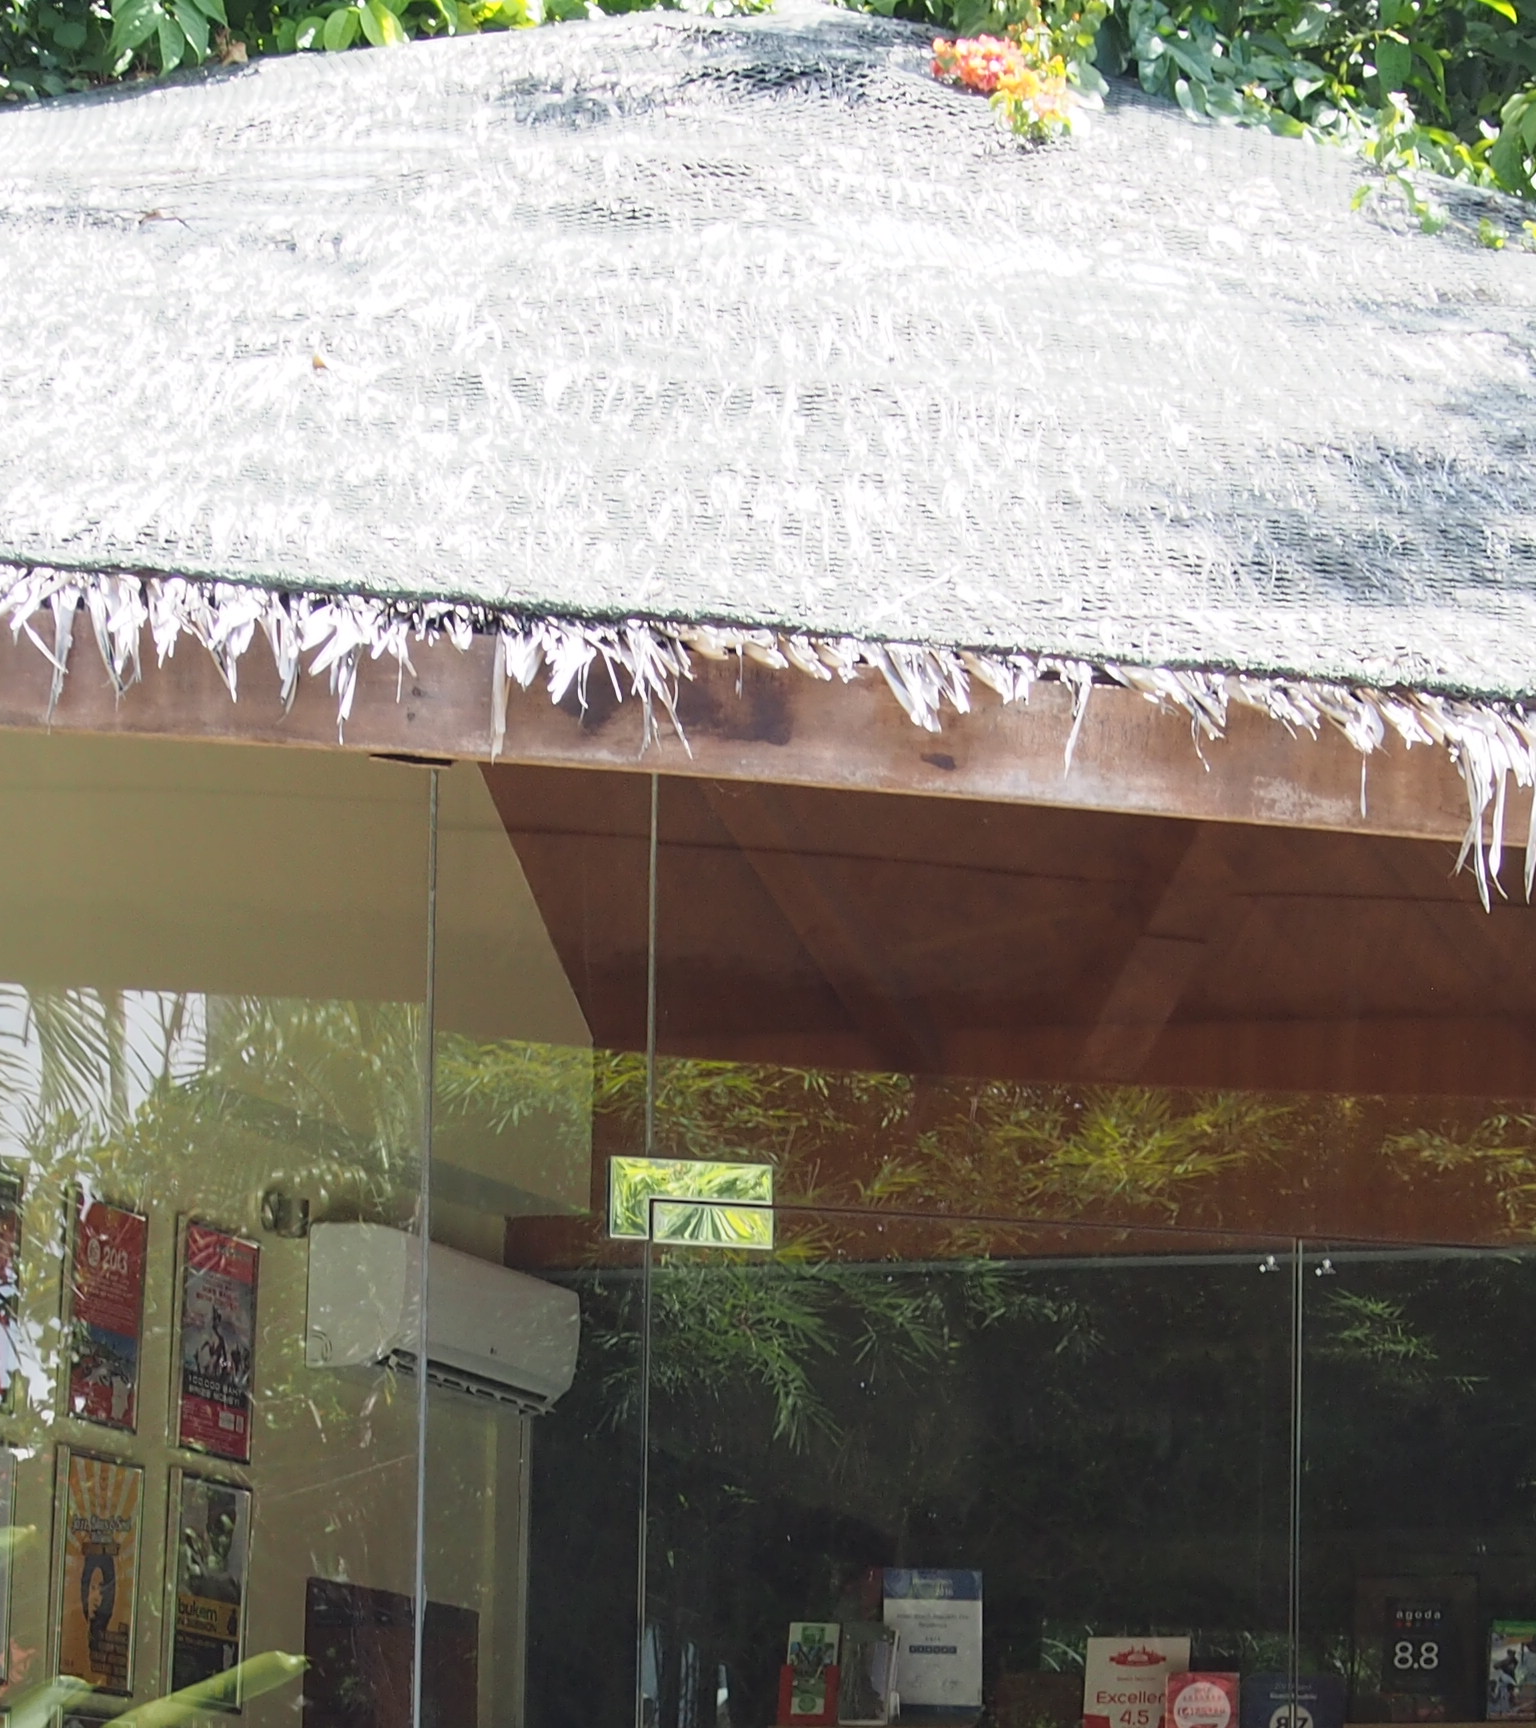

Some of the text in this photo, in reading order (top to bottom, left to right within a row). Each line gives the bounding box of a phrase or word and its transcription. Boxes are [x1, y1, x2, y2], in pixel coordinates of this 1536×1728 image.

[103, 1244, 129, 1276] 2013
[177, 1597, 218, 1622] bukem
[1395, 1608, 1442, 1621] agoda
[1392, 1640, 1439, 1670] 8.8
[1119, 1709, 1150, 1726] 4.5
